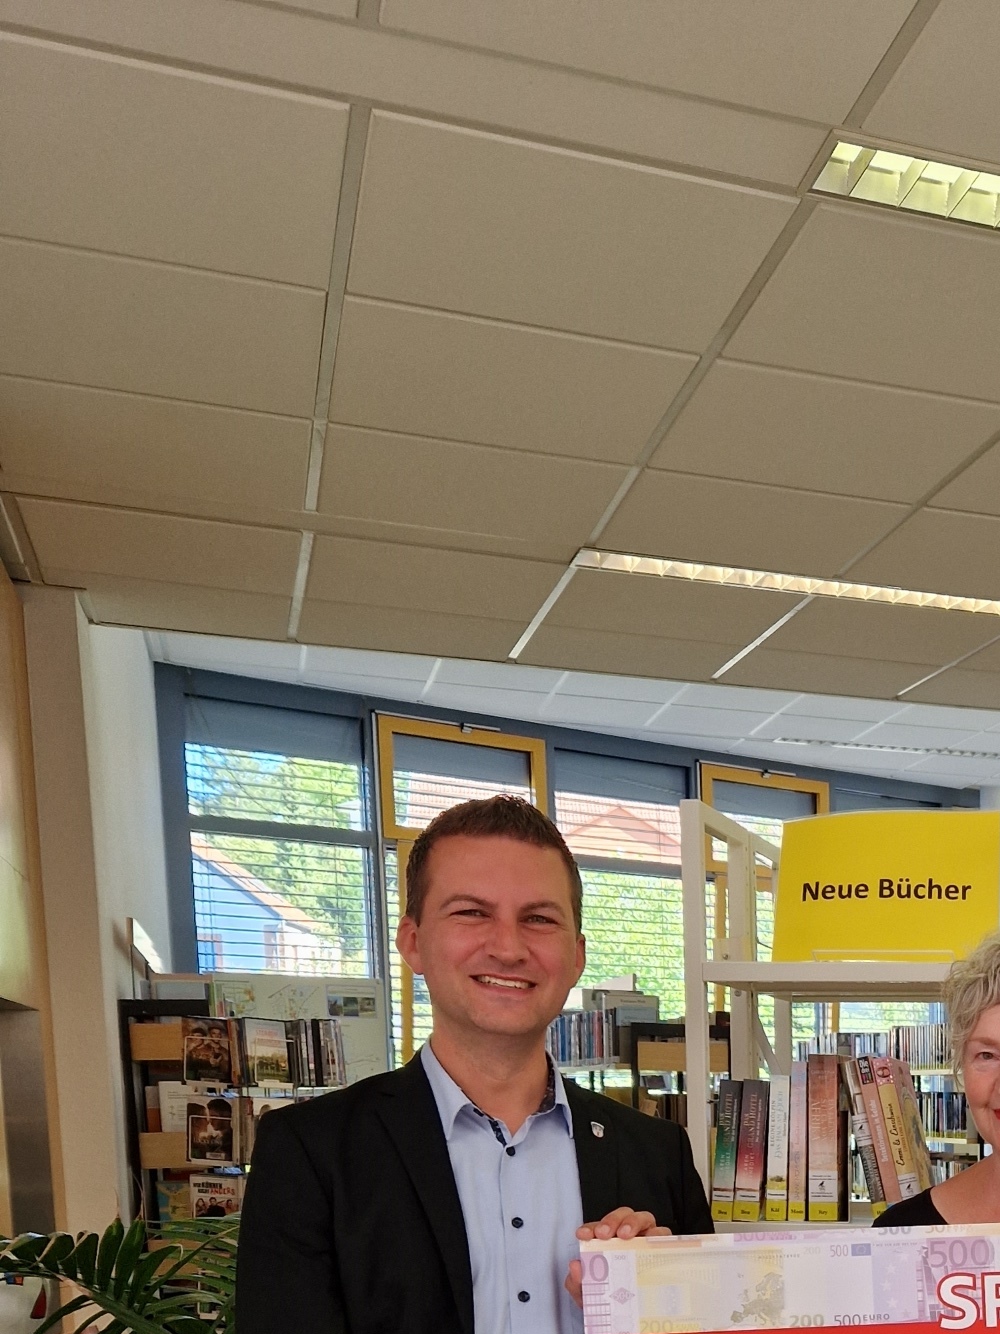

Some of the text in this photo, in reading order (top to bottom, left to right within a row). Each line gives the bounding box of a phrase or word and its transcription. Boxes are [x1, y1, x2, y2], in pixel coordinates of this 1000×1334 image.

[802, 878, 972, 902] Neue Bücher
[811, 1100, 821, 1141] AFRIKA
[209, 1187, 235, 1195] ANDERS
[830, 1244, 849, 1257] 500
[928, 1238, 992, 1268] 500
[833, 1312, 890, 1327] 500 EURO
